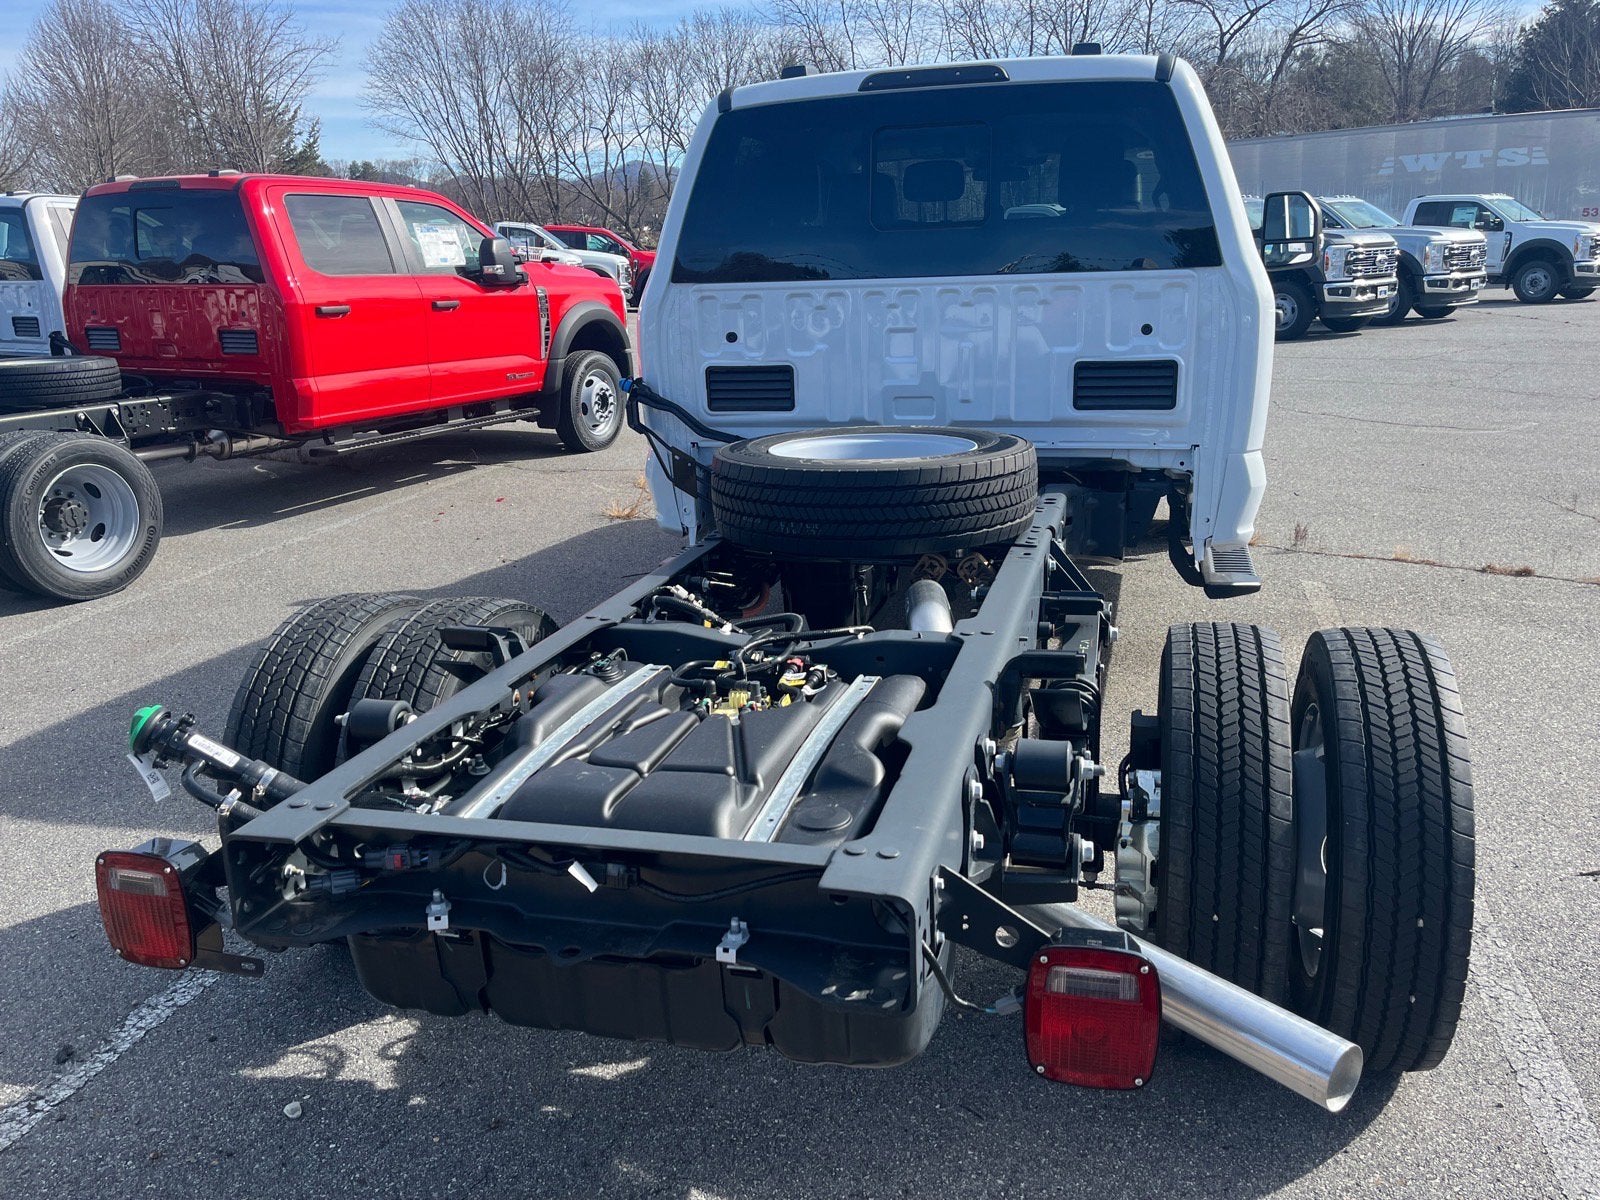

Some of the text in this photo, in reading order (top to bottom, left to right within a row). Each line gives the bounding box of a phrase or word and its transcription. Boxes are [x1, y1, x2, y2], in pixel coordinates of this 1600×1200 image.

[1400, 147, 1531, 173] WTS
[1582, 207, 1599, 217] 53
[123, 525, 157, 578] Continental
